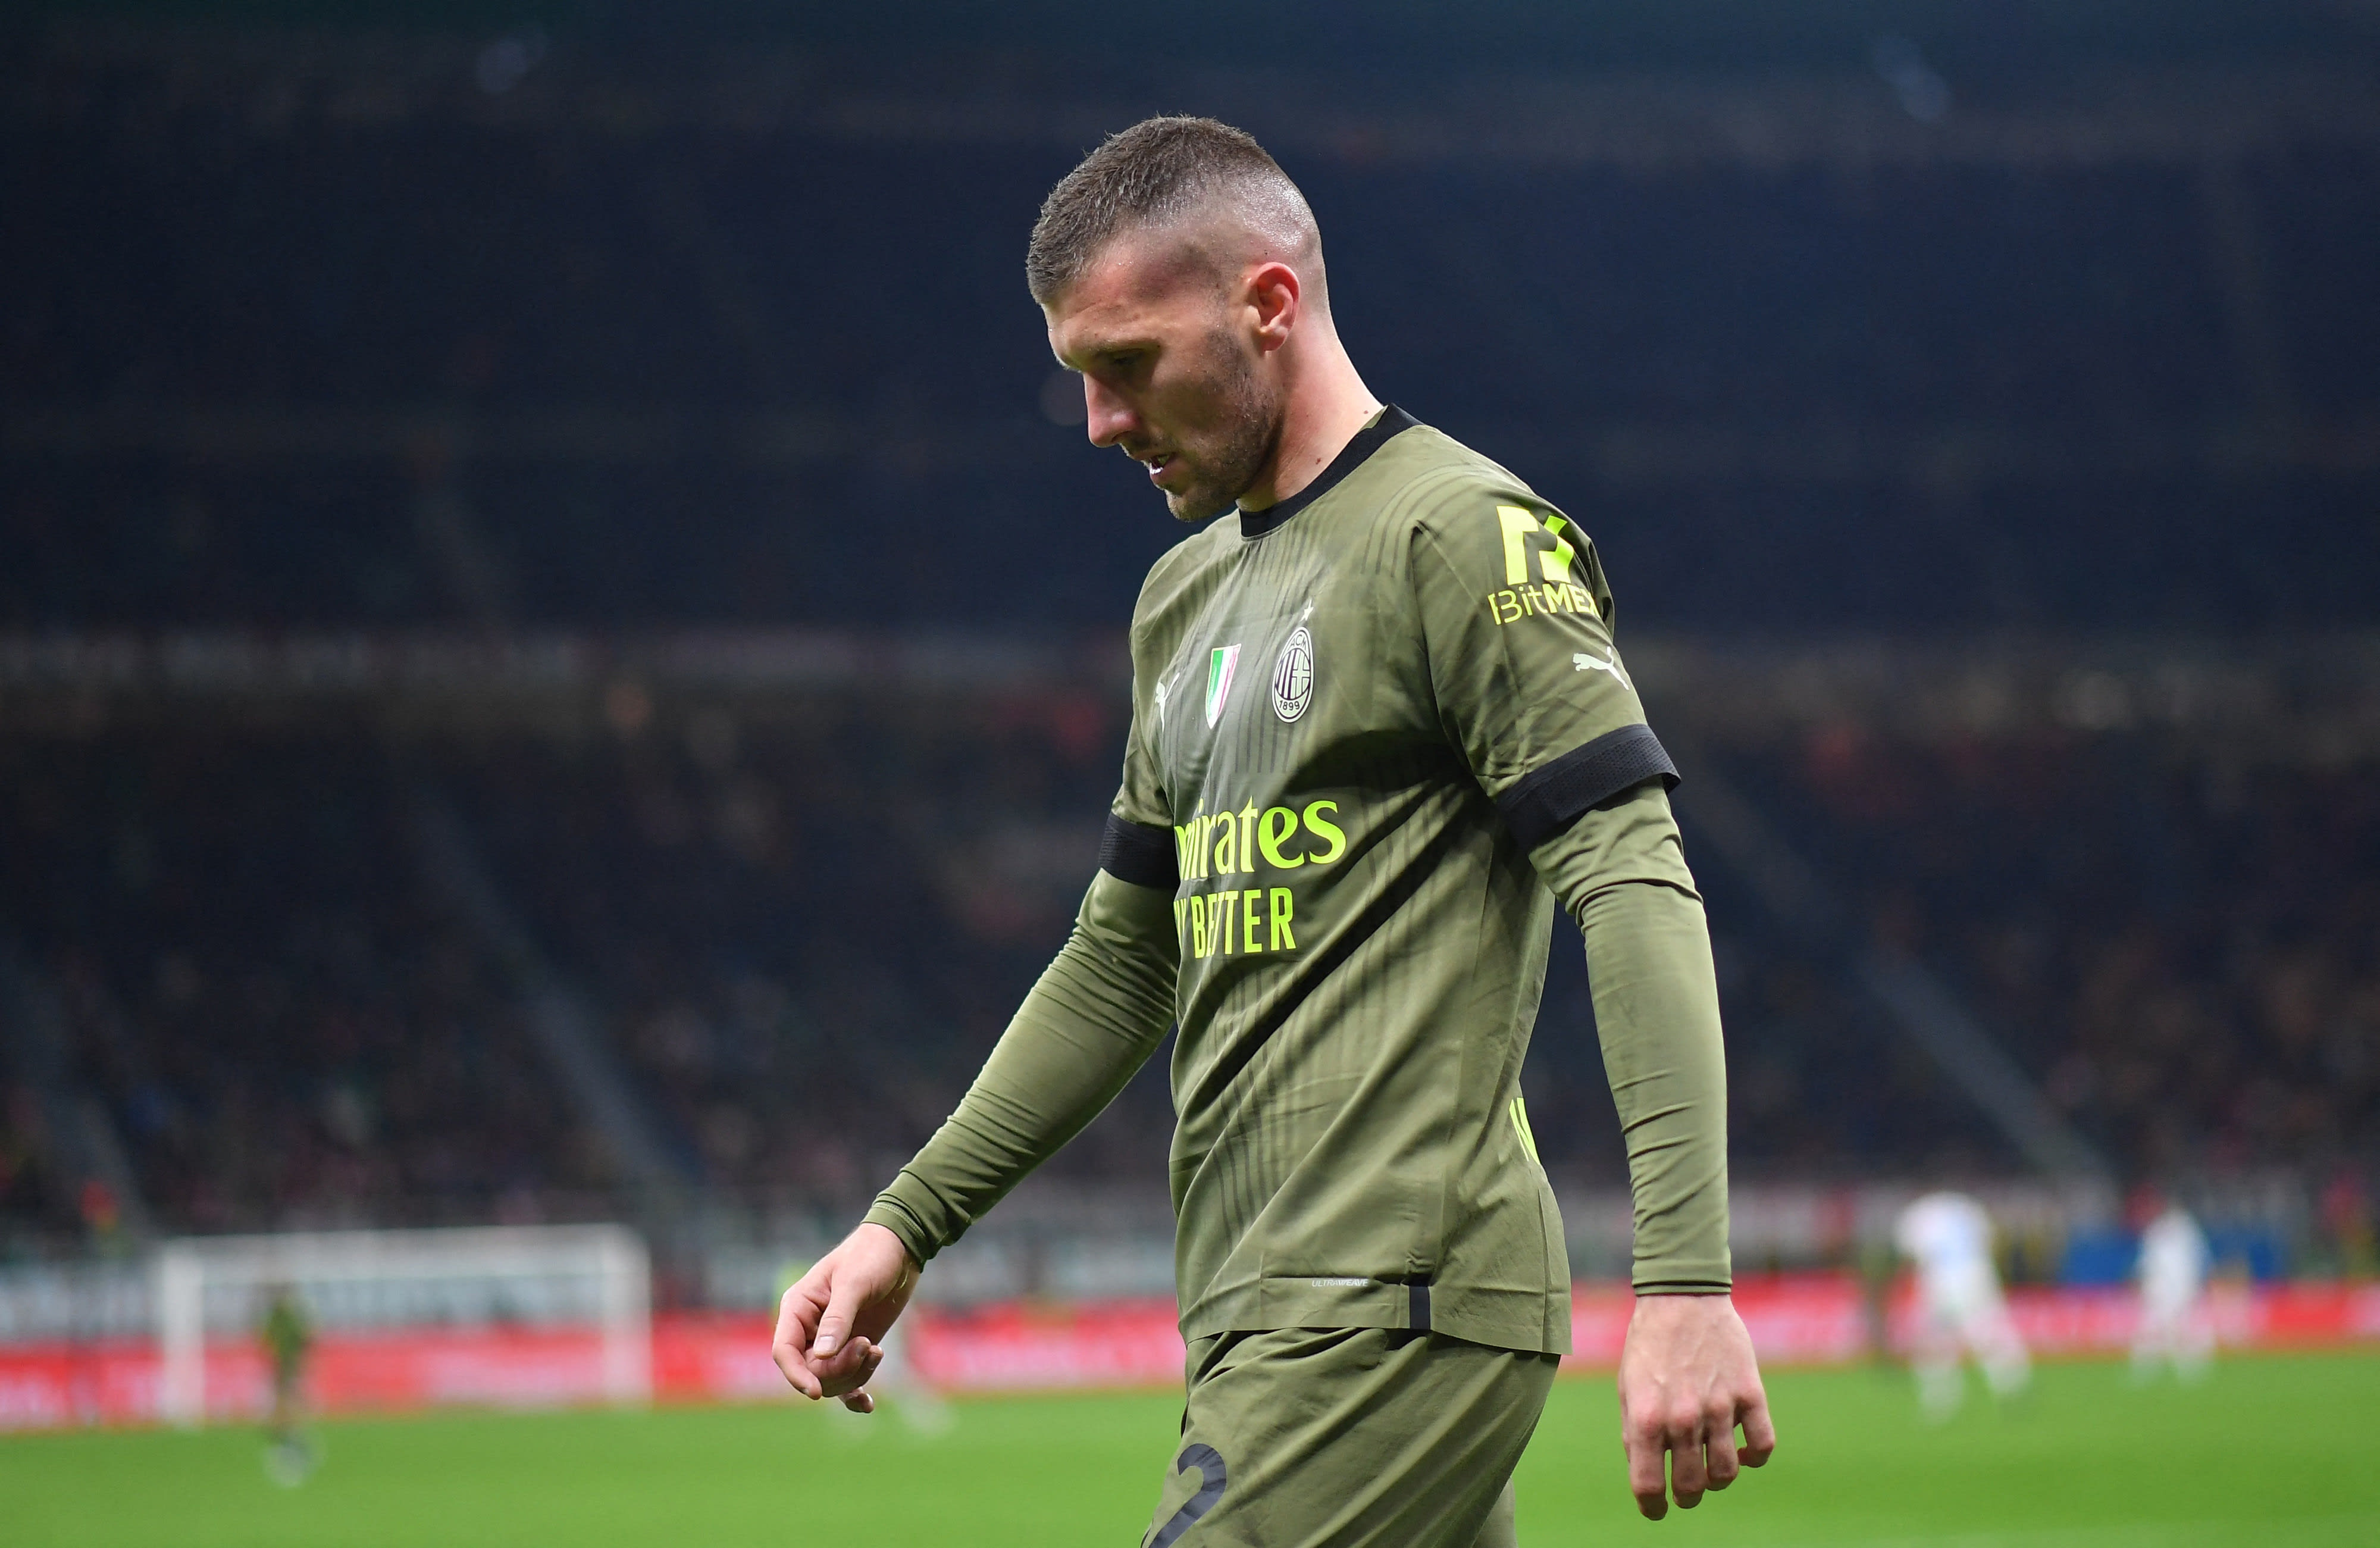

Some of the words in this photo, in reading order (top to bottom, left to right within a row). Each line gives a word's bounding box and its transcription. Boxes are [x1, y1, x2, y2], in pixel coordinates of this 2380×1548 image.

[1291, 634, 1307, 651] ACM
[1279, 699, 1301, 711] 1899
[1174, 795, 1346, 881] mirates
[1190, 887, 1297, 959] BETTER
[1311, 1278, 1368, 1287] ULTRAWEAVE
[1147, 1443, 1227, 1548] 2
